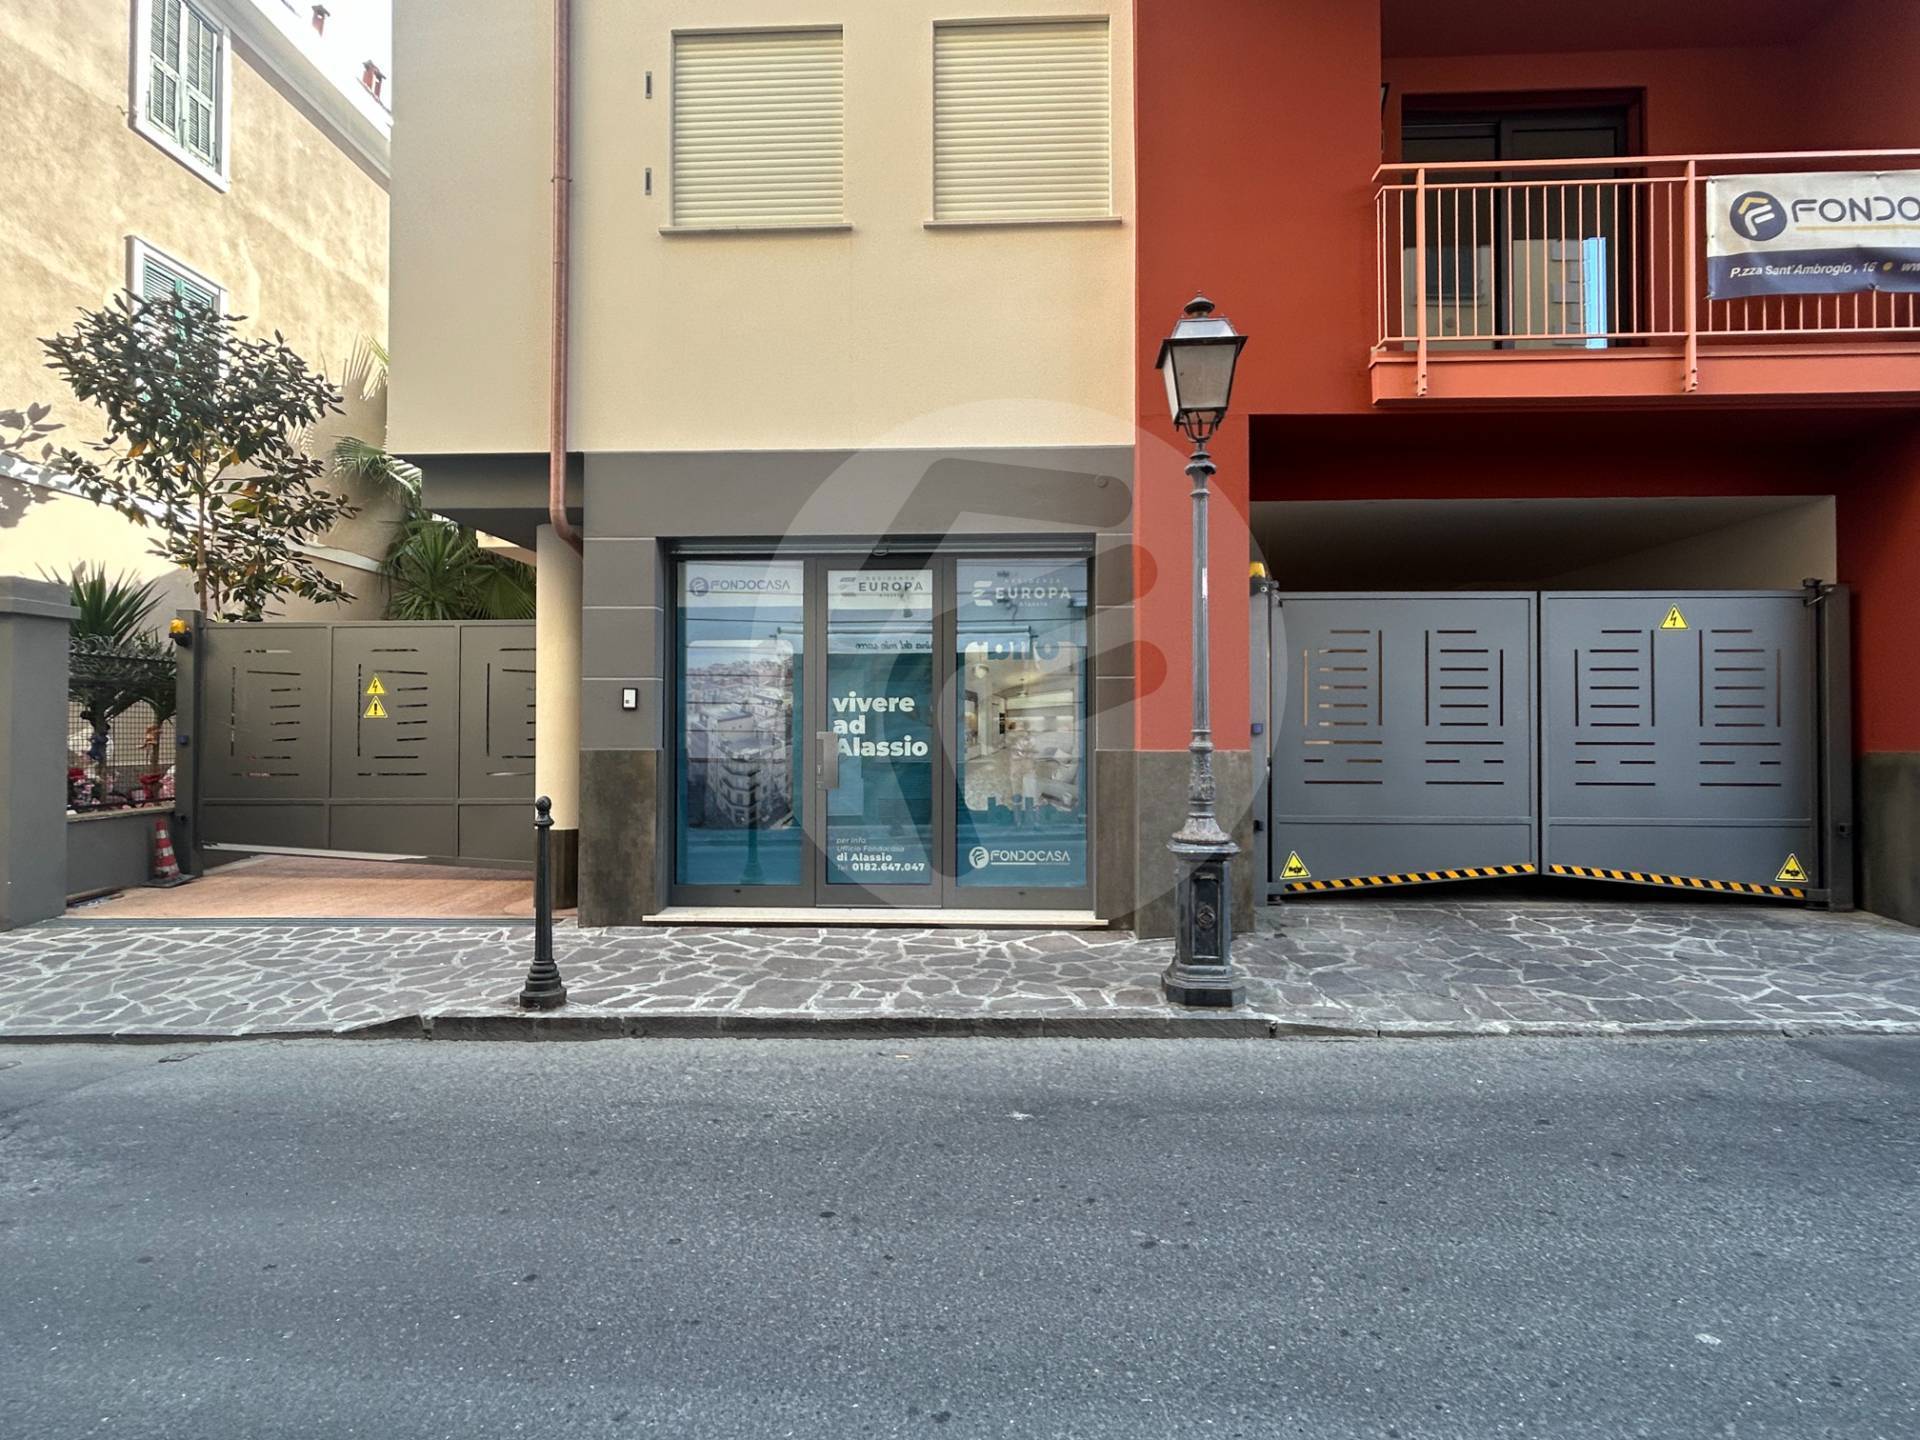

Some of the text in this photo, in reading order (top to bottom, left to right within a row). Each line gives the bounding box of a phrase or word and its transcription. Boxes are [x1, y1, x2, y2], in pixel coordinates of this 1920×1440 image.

[1730, 264, 1763, 279] P.zza
[711, 579, 790, 590] FONDOCASA
[858, 582, 924, 592] EUROPA
[995, 586, 1072, 599] EUROPA
[832, 691, 915, 712] vivere
[833, 714, 866, 735] ad
[838, 735, 928, 757] Alassio
[836, 852, 893, 862] di Alassio
[990, 850, 1071, 862] FONDOCASA
[851, 862, 925, 872] 0182.647.047
